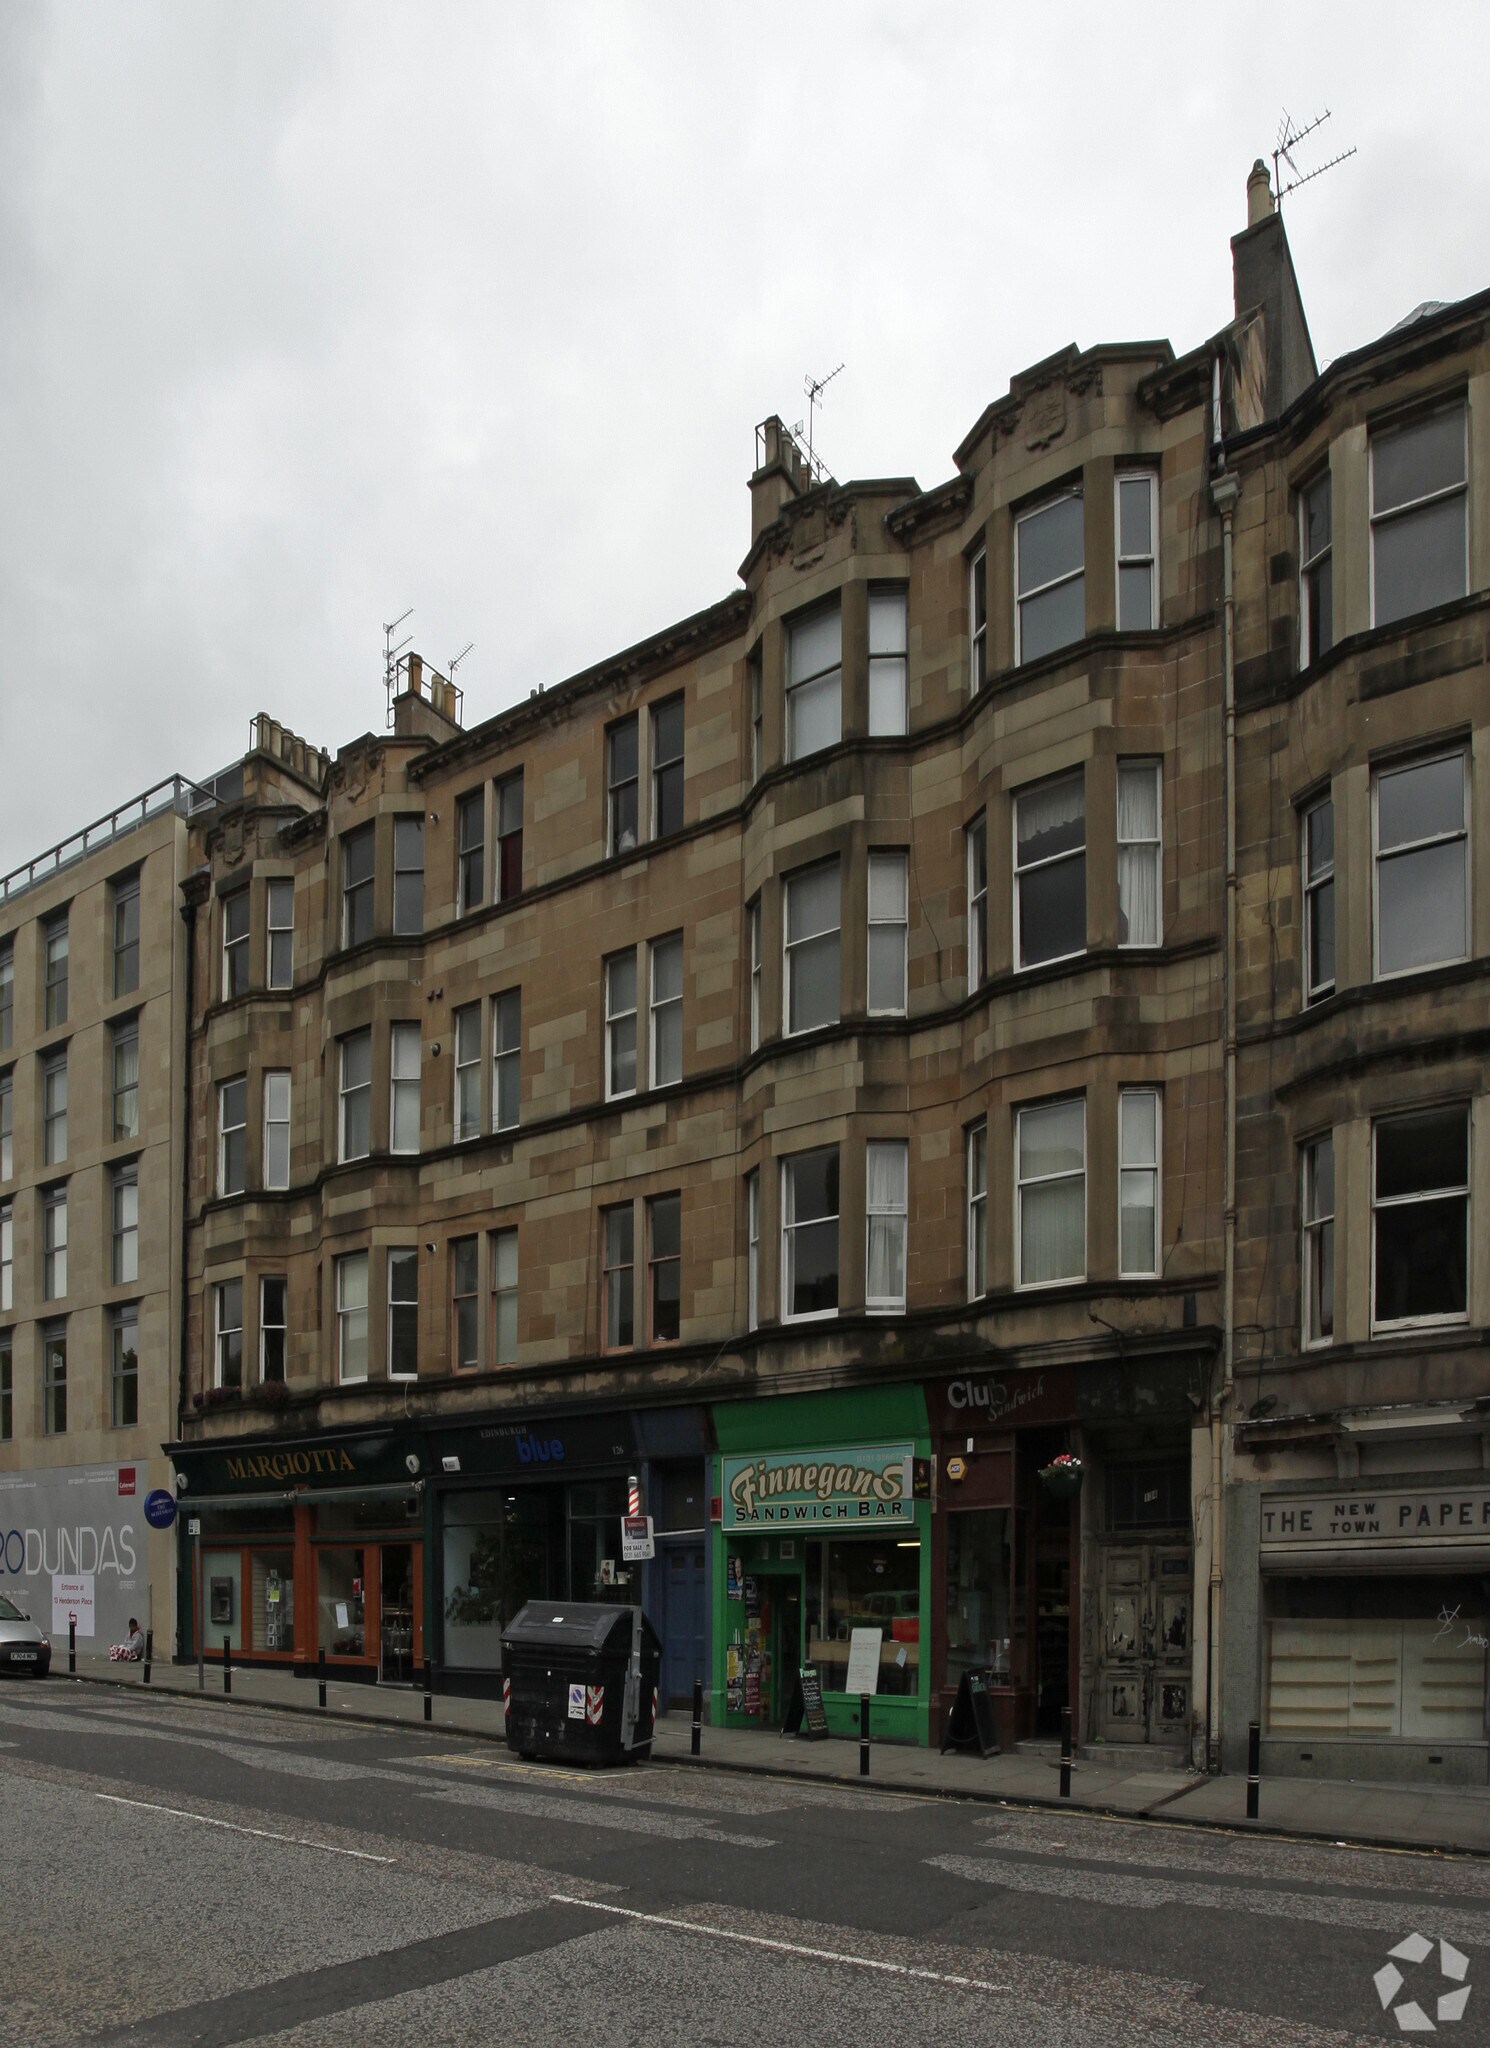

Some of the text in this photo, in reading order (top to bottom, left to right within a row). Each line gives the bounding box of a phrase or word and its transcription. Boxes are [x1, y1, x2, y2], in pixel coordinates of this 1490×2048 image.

[947, 1377, 1008, 1409] Club
[986, 1375, 1046, 1422] Sandwich
[480, 1425, 527, 1439] EDINBURGH
[515, 1433, 566, 1464] blue
[225, 1448, 356, 1480] MARGIOTTA
[730, 1459, 904, 1516] Finnegans
[735, 1501, 903, 1521] SANDWICH BAR
[1335, 1503, 1376, 1516] NEW
[1264, 1511, 1313, 1533] THE
[1330, 1521, 1380, 1533] TOWN
[61, 1583, 78, 1591] Entrance
[59, 1597, 80, 1605] Henderson
